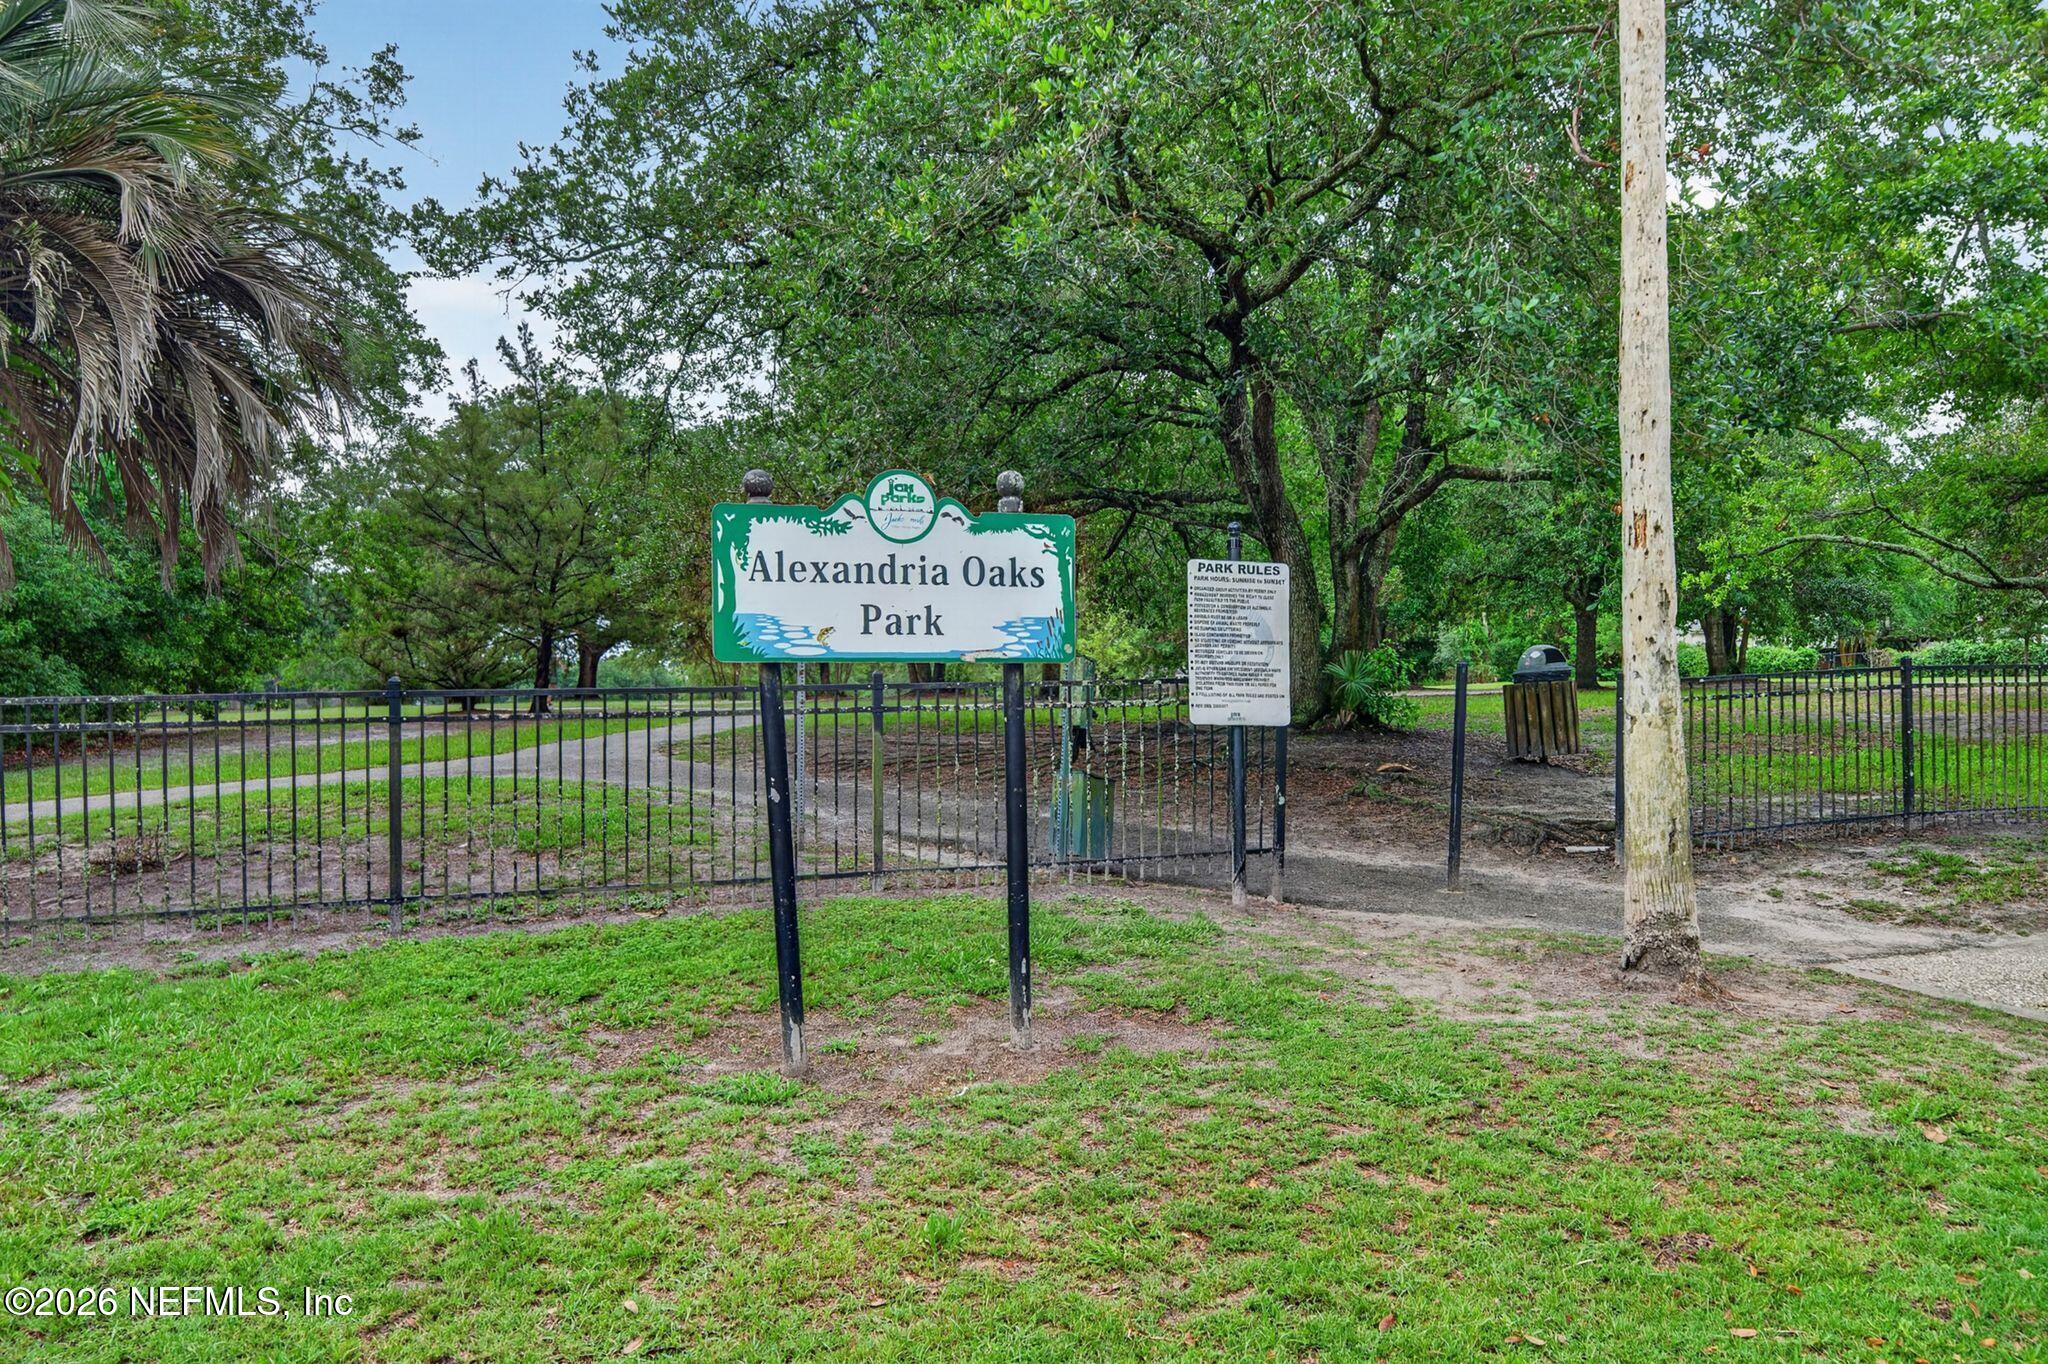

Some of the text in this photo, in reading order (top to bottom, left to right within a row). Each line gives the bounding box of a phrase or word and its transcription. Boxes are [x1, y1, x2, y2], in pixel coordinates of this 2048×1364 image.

[880, 491, 925, 506] parks
[748, 550, 1046, 588] Alexandria Oaks
[1198, 562, 1280, 575] PARK RULES
[860, 604, 945, 636] Park
